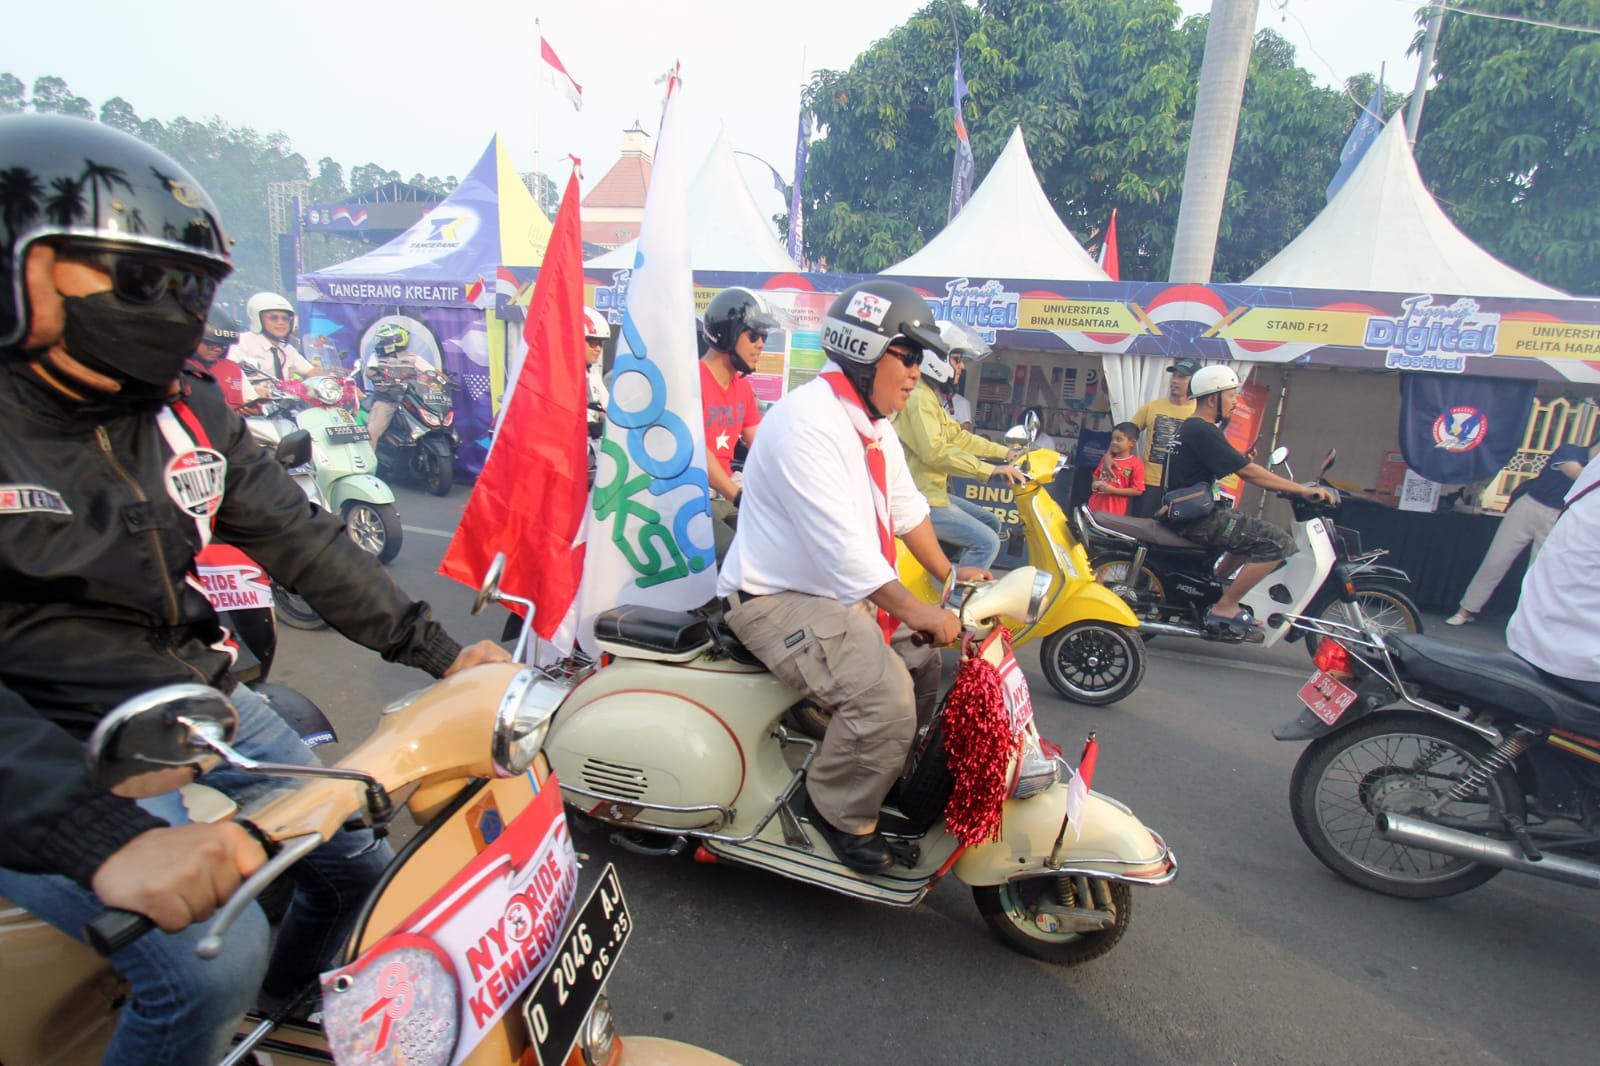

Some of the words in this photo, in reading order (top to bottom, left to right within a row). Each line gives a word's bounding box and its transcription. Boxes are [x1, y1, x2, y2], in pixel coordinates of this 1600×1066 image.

[328, 283, 401, 298] TANGERANG
[405, 285, 460, 301] KREATIF
[1043, 304, 1110, 316] UNIVERSITAS
[842, 326, 852, 336] THE
[1031, 316, 1055, 326] BINA
[1057, 317, 1120, 329] NUSANTARA
[1266, 320, 1305, 331] STAND
[1307, 322, 1329, 333] F12
[823, 327, 869, 357] POLICE
[1367, 317, 1497, 355] Digital
[1515, 340, 1561, 352] PELITA
[1388, 352, 1464, 371] Festival
[965, 484, 1016, 504] BINU
[531, 1003, 549, 1044] D
[553, 923, 593, 1006] 2046
[601, 873, 620, 920] AJ
